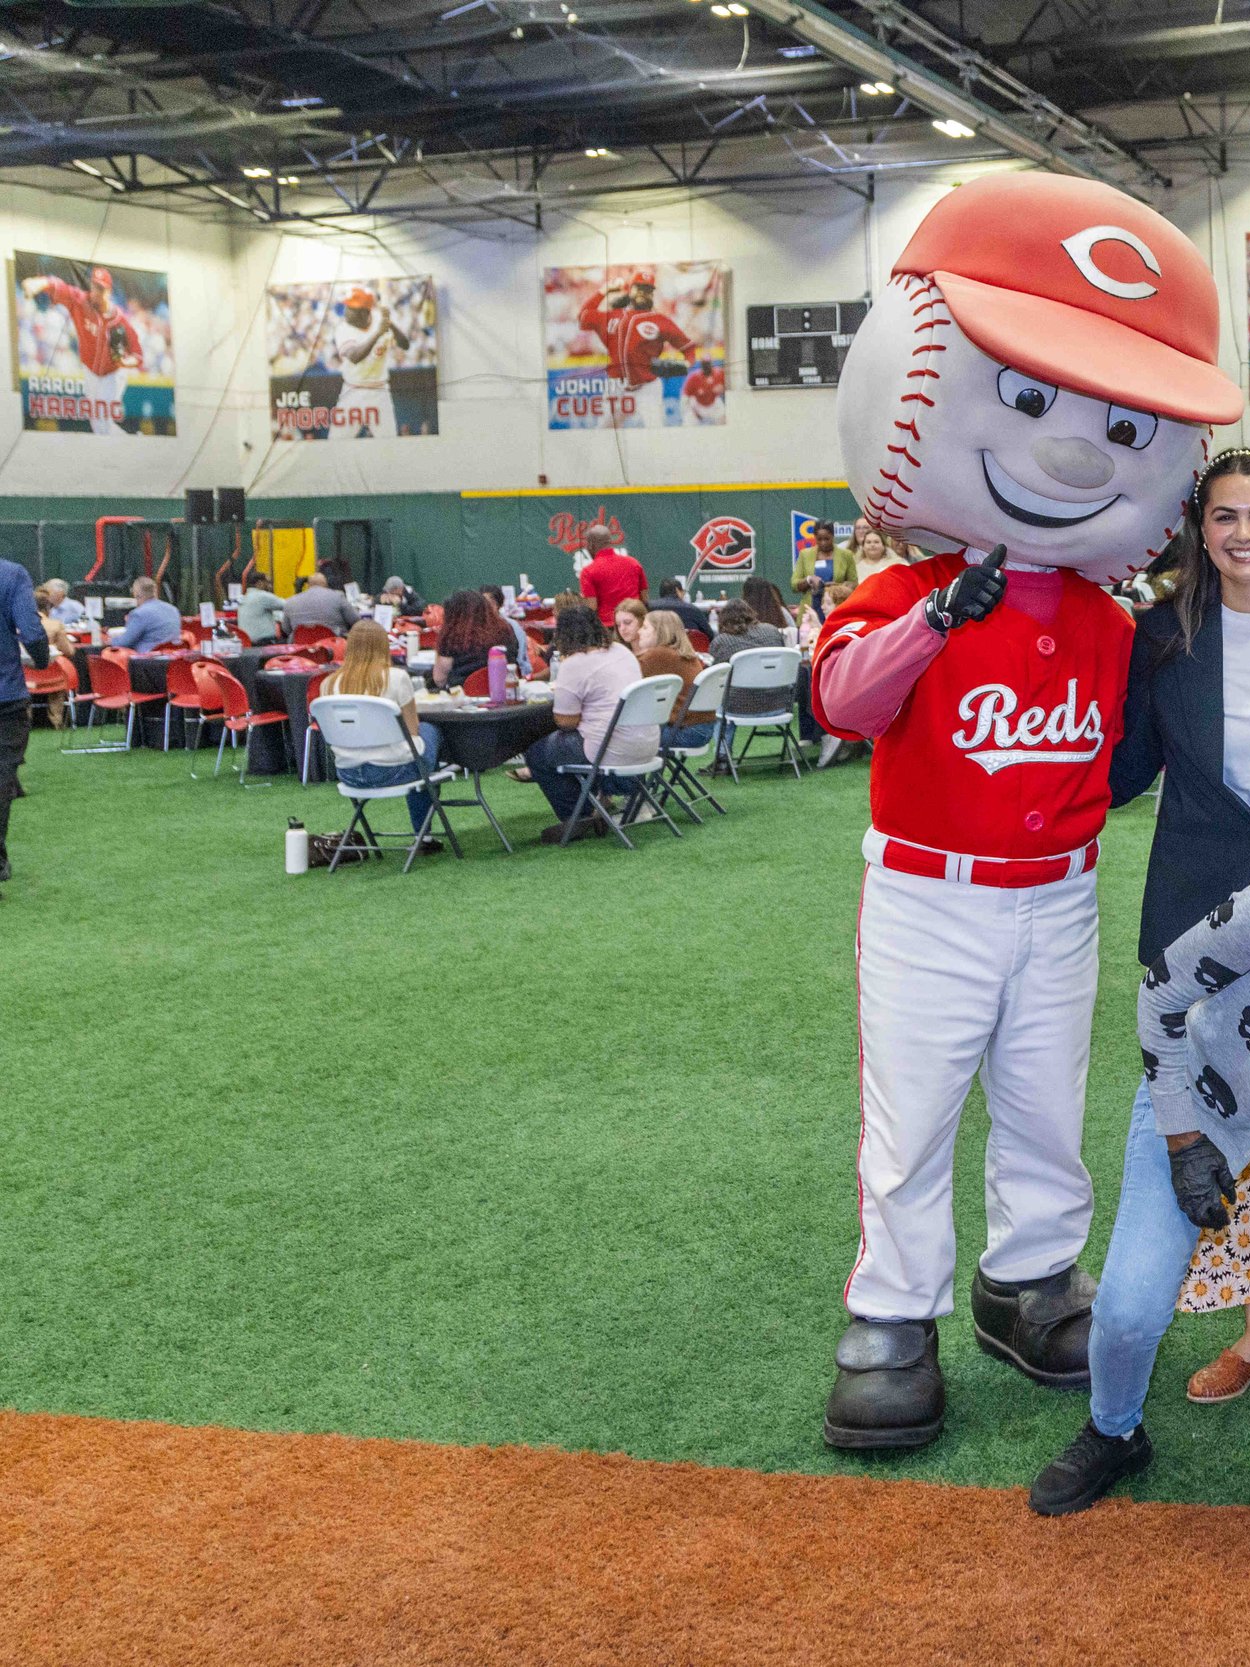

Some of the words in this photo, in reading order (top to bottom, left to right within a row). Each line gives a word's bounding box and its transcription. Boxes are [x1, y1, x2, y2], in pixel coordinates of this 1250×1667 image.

[28, 376, 84, 395] AARON
[555, 378, 629, 395] JOHNNY
[28, 393, 125, 422] HARANG
[276, 391, 312, 408] JOE
[556, 395, 636, 417] CUETO
[276, 406, 380, 430] MORGAN
[951, 677, 1105, 776] Reds
